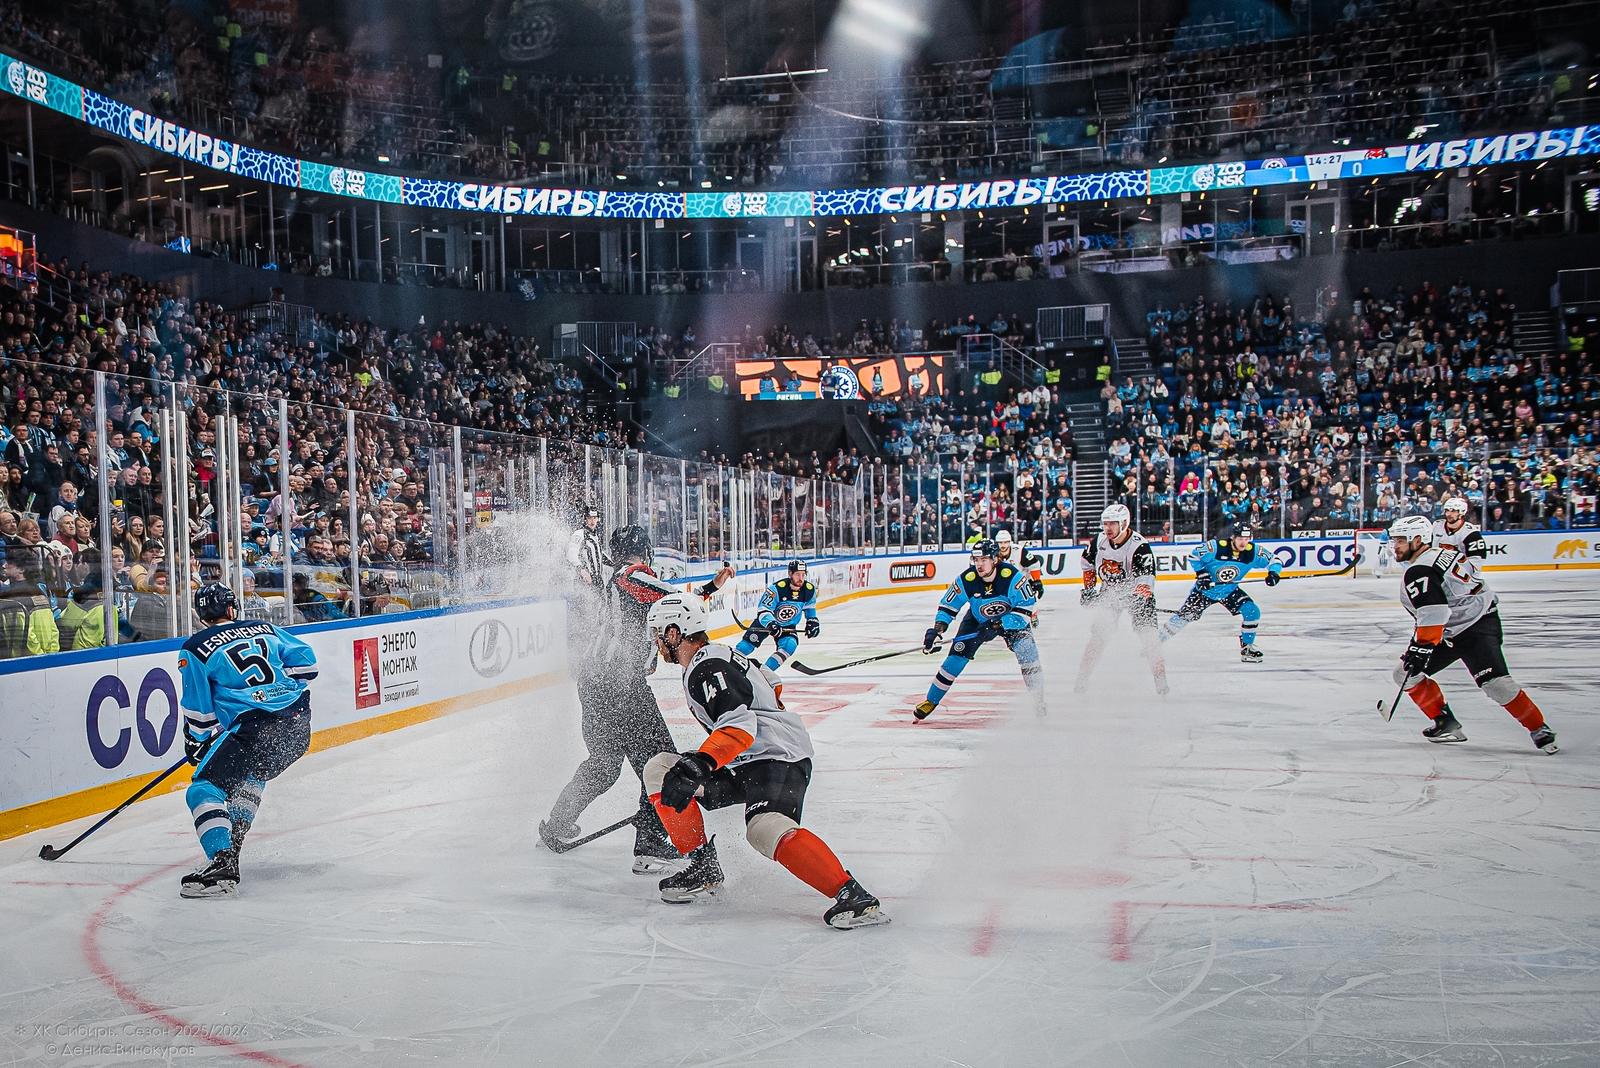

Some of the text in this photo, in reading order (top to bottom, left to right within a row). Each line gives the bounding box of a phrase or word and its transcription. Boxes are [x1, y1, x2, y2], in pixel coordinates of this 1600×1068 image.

[25, 65, 48, 87] ZOO
[26, 83, 49, 104] NSK
[128, 109, 240, 173] СИБИРЬ!
[1309, 155, 1342, 165] 14:27
[346, 168, 365, 184] ZOO
[1217, 162, 1246, 175] ZOO
[1289, 168, 1299, 182] 1
[1352, 162, 1362, 176] 0
[1217, 174, 1245, 187] NSK
[346, 182, 365, 197] NSK
[879, 176, 1058, 212] СИБИРЬ!
[457, 183, 608, 217] СИБИРЬ!
[743, 192, 767, 204] ZOO
[743, 204, 767, 216] NSK
[1468, 540, 1485, 552] 26
[892, 564, 925, 579] WINLINE
[1406, 576, 1429, 599] 57
[199, 597, 207, 607] 51
[762, 592, 774, 607] 22
[197, 624, 274, 658] LESHCHENKO
[382, 631, 417, 653] ЭНЕРГО
[223, 637, 276, 687] 51
[382, 656, 418, 677] МОНТАЖ
[702, 671, 728, 703] 41
